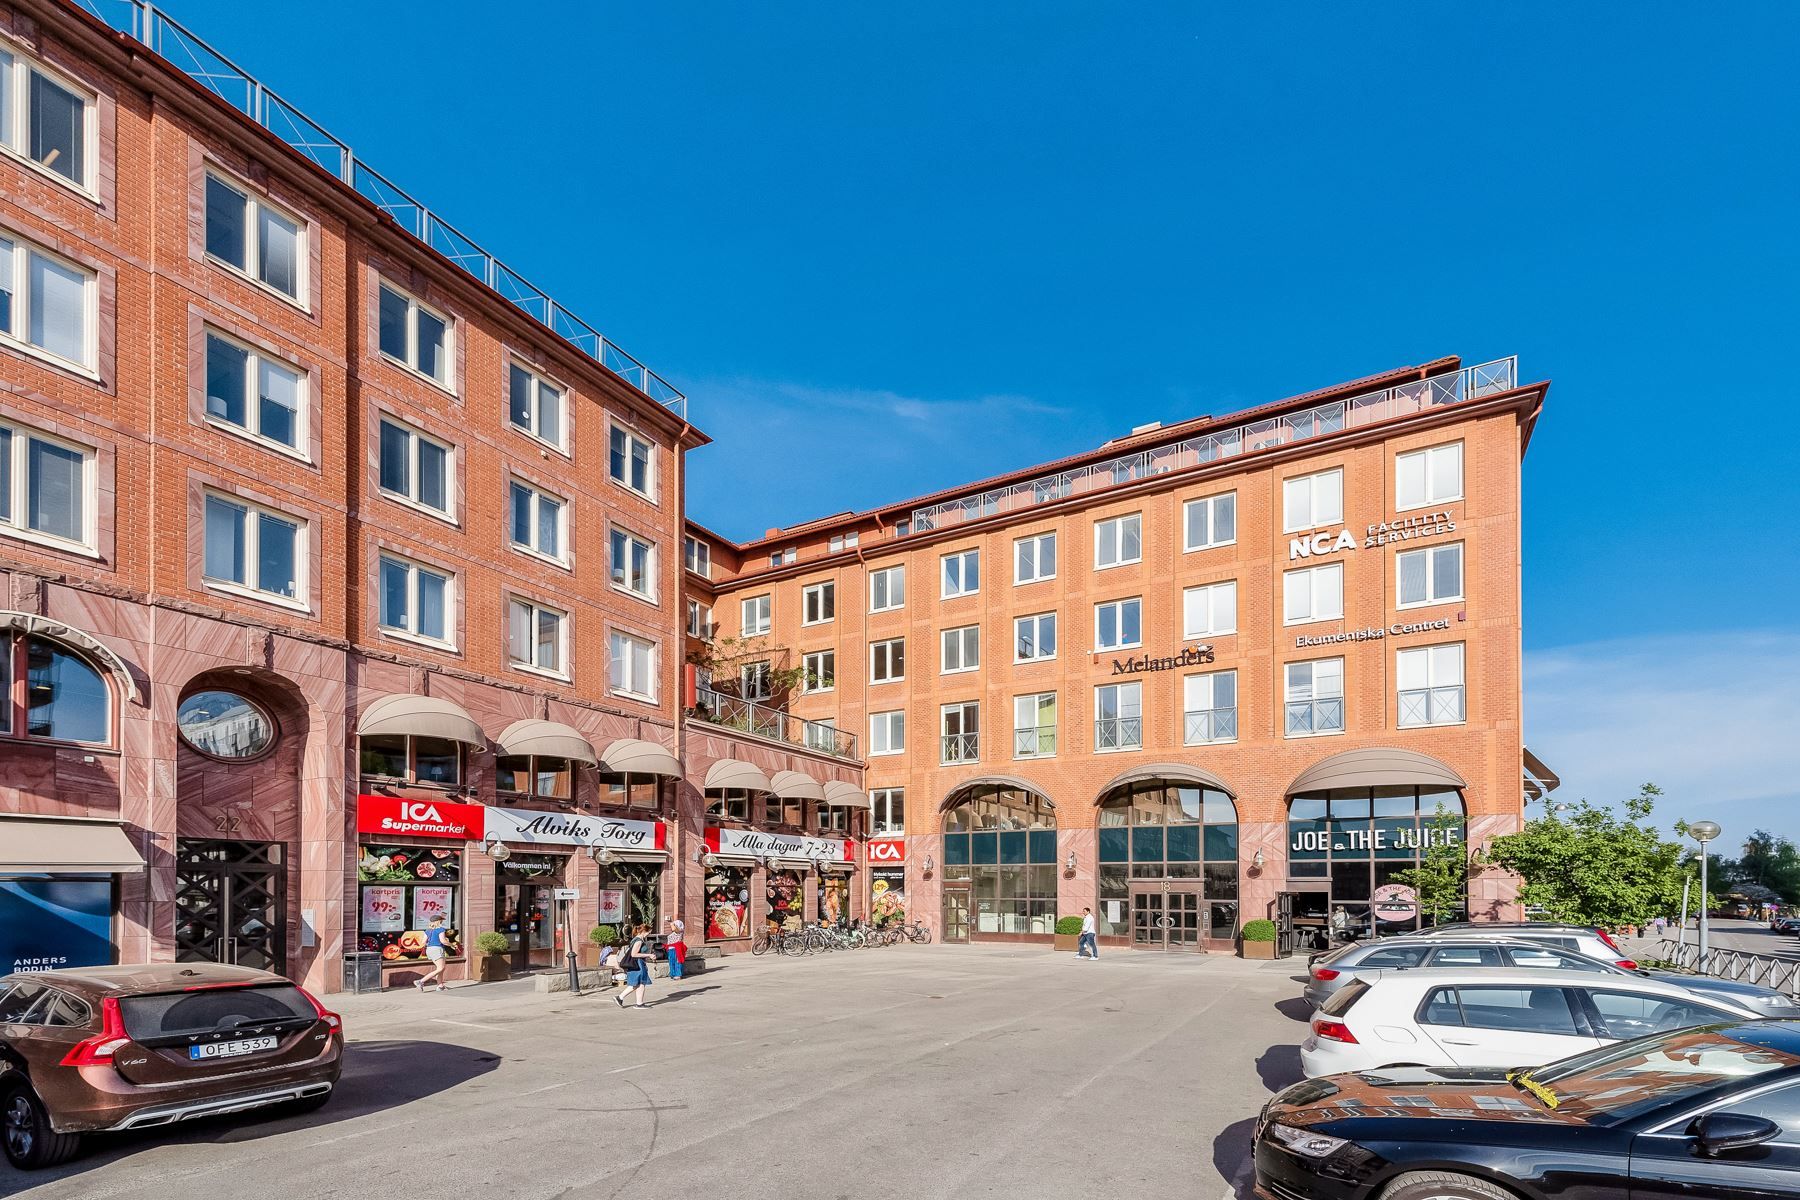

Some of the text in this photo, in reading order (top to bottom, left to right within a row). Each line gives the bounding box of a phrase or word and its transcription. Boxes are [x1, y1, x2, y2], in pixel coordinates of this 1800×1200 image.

[1367, 510, 1453, 536] FACILITY
[1365, 521, 1457, 548] SERVICES
[1290, 529, 1357, 560] NCA
[1296, 618, 1450, 648] Ekumeniska Centret
[1112, 650, 1215, 675] Melanders
[401, 802, 443, 823] ICA
[215, 815, 241, 832] 22
[381, 818, 465, 834] Supermarket
[516, 815, 646, 845] Alviks Torg
[733, 834, 766, 849] Alla
[767, 837, 803, 855] dagar
[1292, 831, 1329, 851] JOE
[1346, 829, 1386, 850] THE
[870, 843, 902, 860] ICA
[502, 861, 542, 870] Välkommen
[1161, 881, 1171, 891] 18
[13, 956, 67, 966] ANDERS
[13, 965, 53, 973] BODIN
[205, 1043, 237, 1056] OFE
[241, 1038, 271, 1051] 539
[121, 1058, 148, 1066] V60
